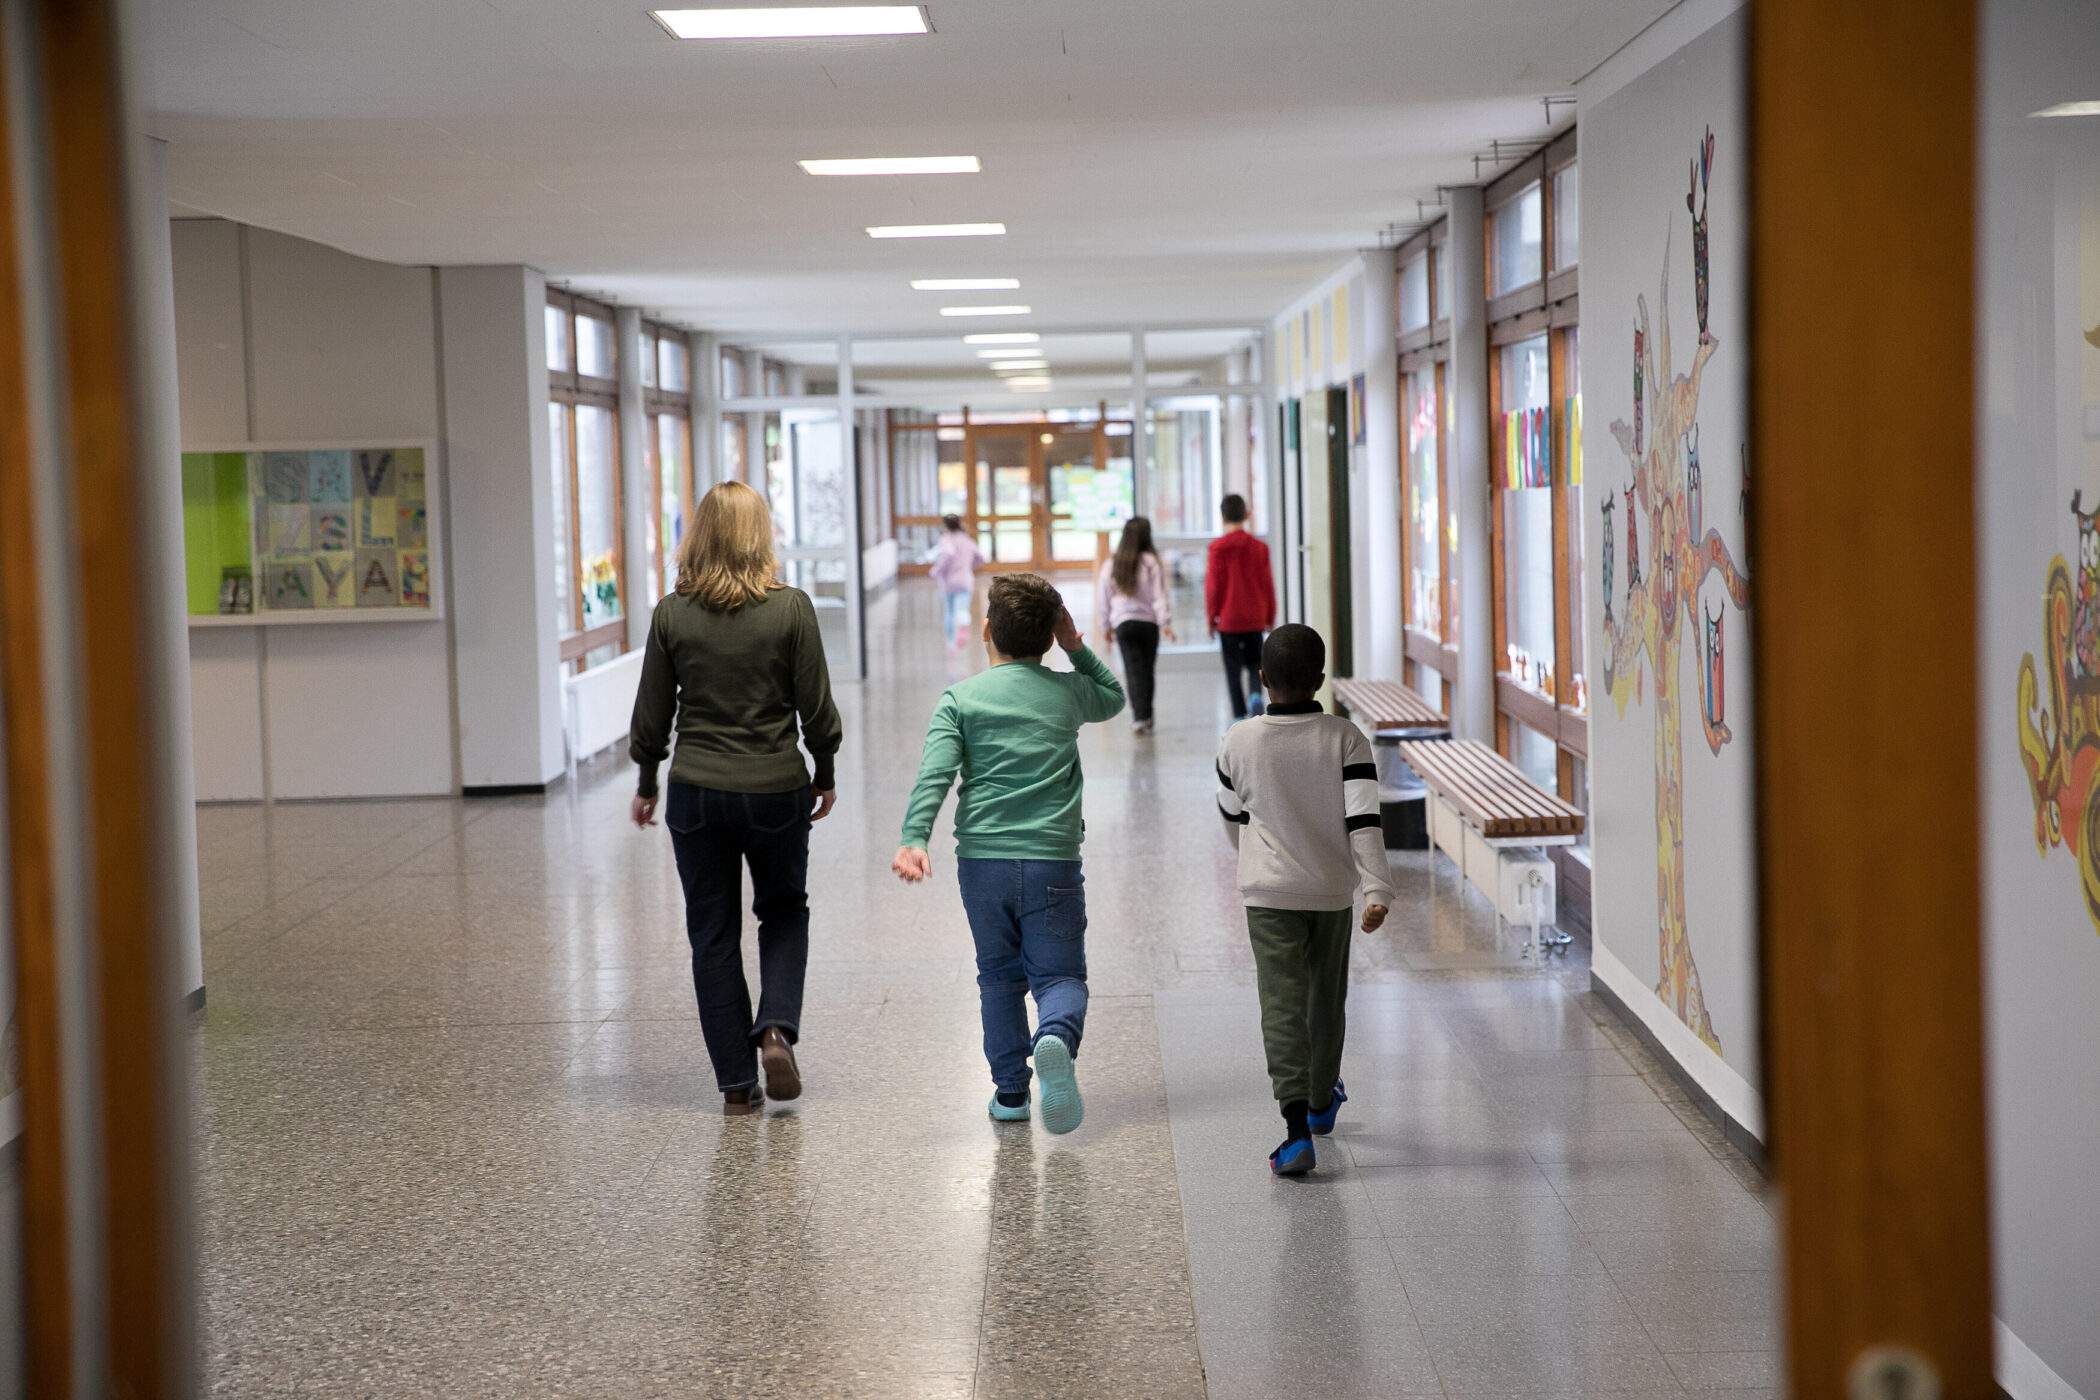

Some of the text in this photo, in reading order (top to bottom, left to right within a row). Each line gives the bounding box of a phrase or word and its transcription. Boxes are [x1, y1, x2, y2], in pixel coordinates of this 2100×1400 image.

[360, 453, 392, 496] V
[319, 514, 347, 551] S
[361, 498, 394, 545] L
[277, 564, 308, 598] A
[315, 557, 351, 601] Y
[360, 560, 392, 595] A
